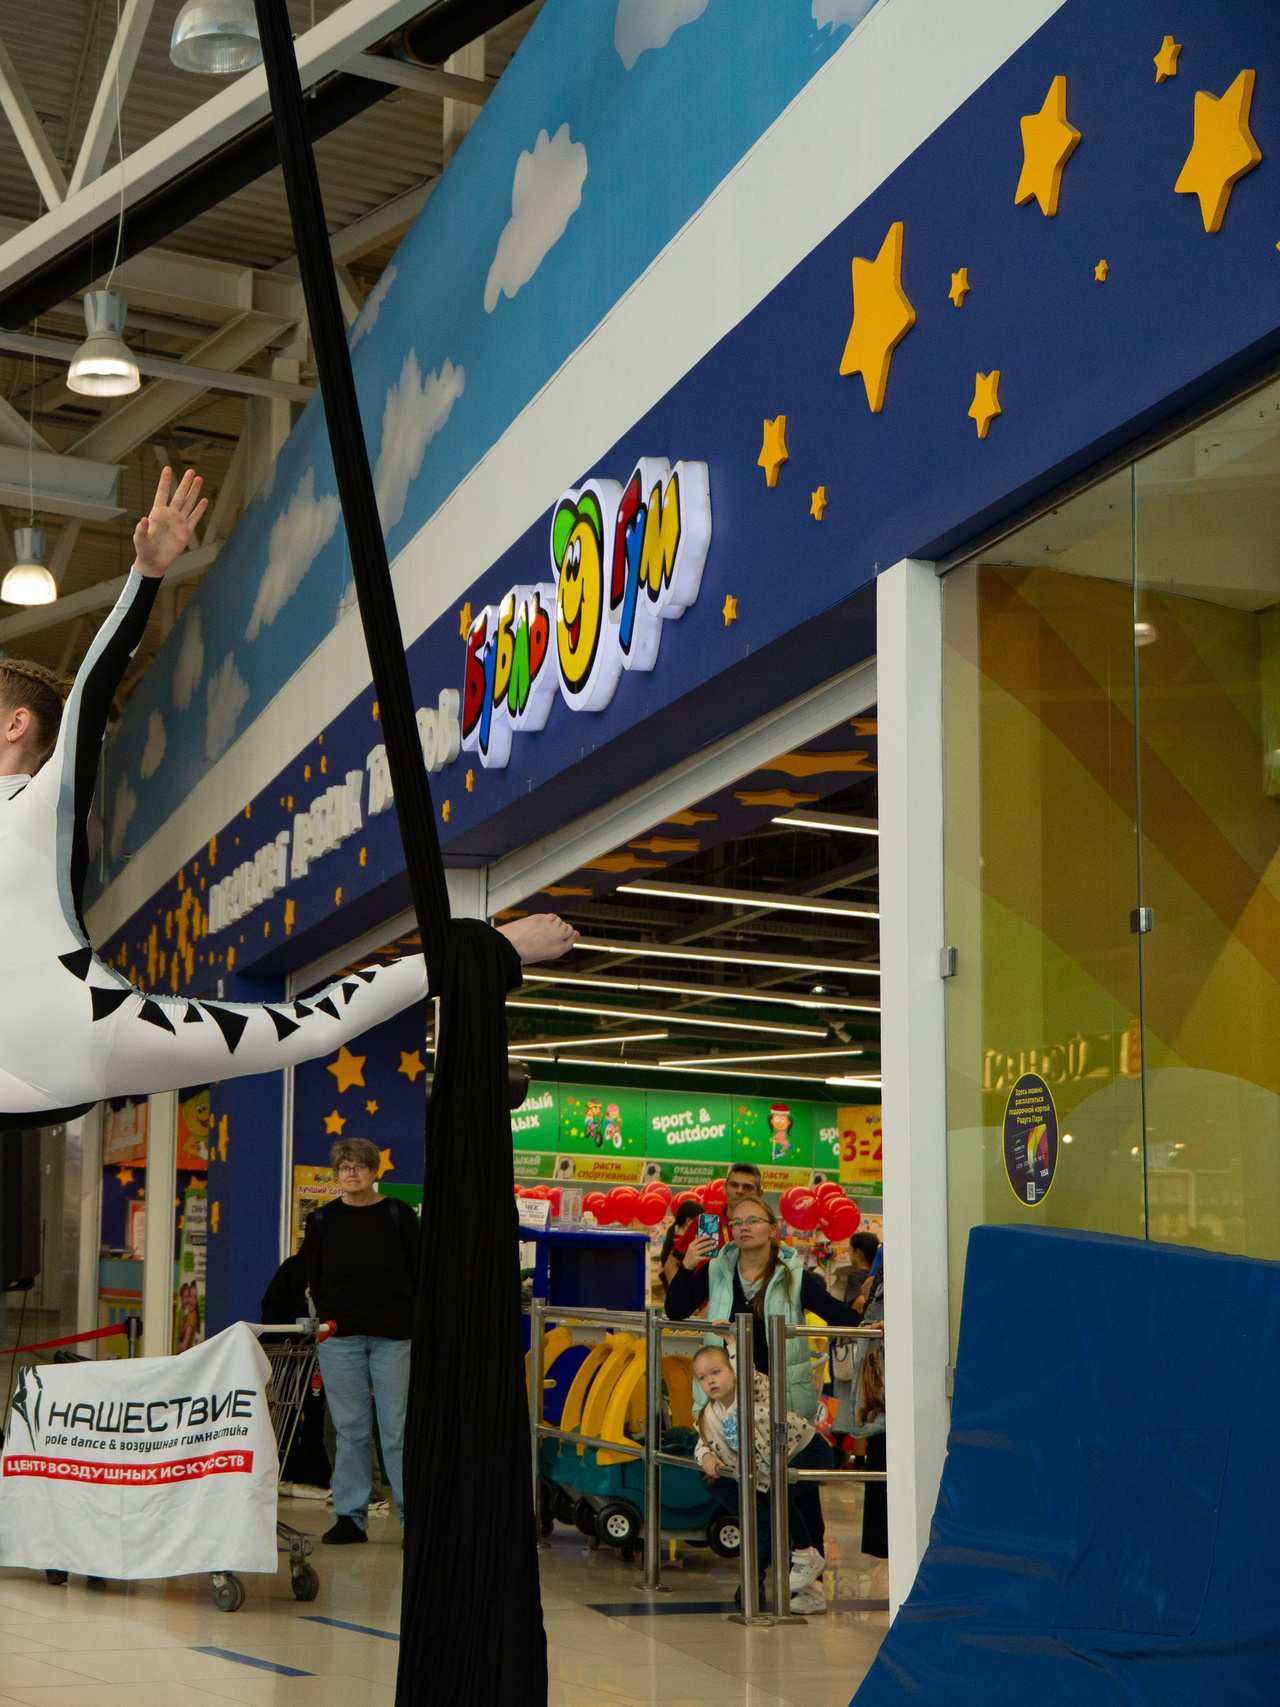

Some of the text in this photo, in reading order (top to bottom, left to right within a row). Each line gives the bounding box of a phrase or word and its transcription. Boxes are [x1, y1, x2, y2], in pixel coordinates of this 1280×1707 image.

[1009, 1103, 1050, 1116] подарочной картой
[1015, 1096, 1044, 1106] расплатиться
[652, 1108, 711, 1133] sport &
[1017, 1115, 1043, 1125] Радуга Парк
[666, 1123, 726, 1145] outdoor
[48, 1389, 257, 1433] НАШЕСТВИЕ
[45, 1424, 249, 1453] pole dance & воздушная гимнастика
[7, 1455, 245, 1481] ЦЕНТР ВОЗДУШНЫХ ИСКУССТВ
